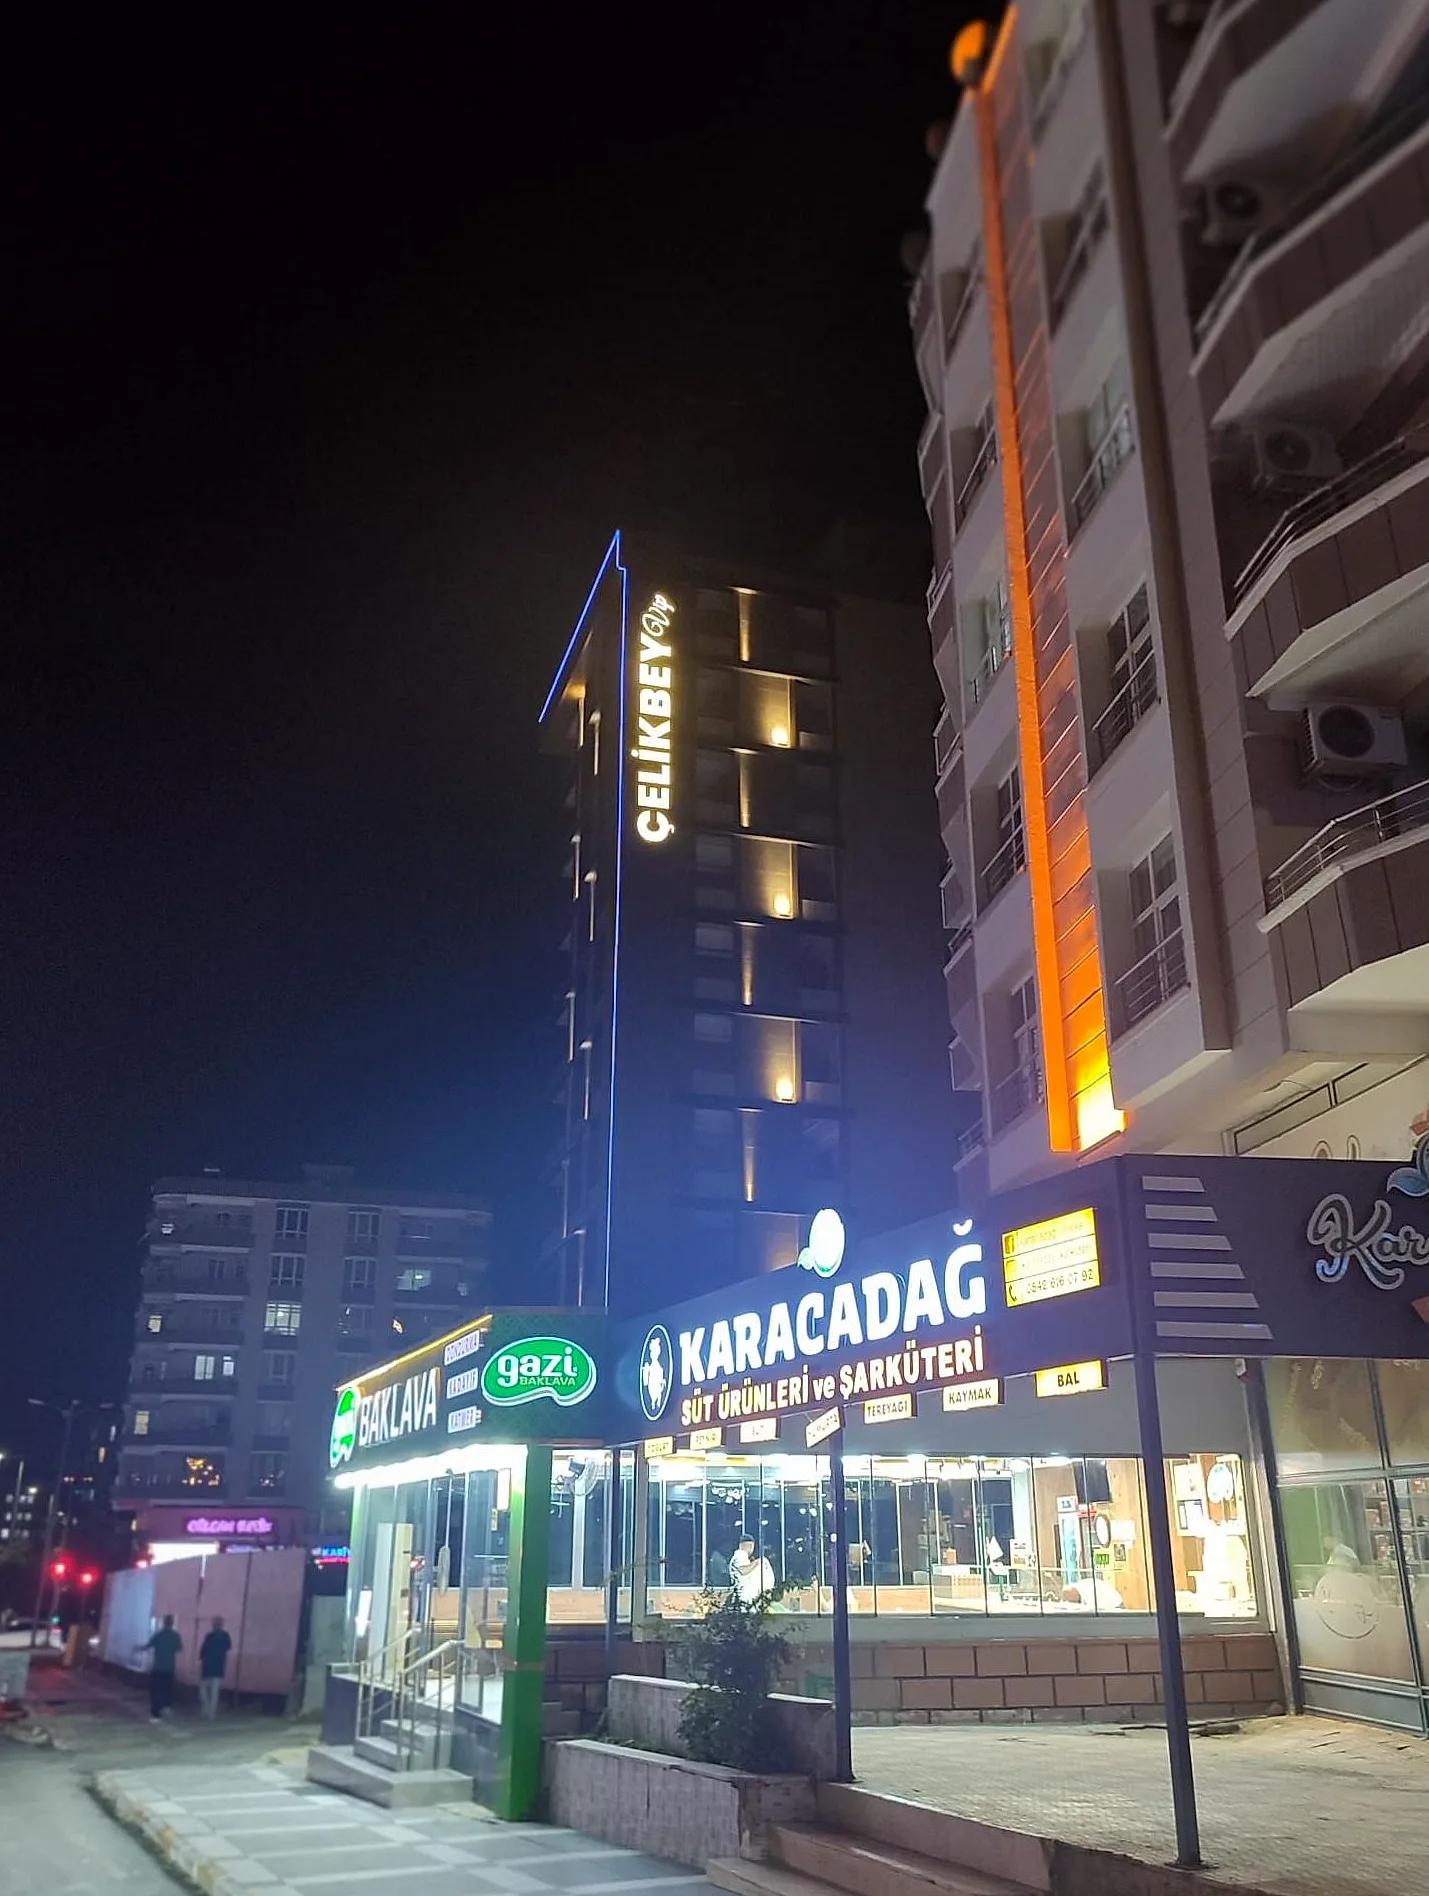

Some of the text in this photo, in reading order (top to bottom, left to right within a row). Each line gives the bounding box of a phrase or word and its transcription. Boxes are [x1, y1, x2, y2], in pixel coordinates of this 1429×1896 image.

[630, 632, 675, 843] ÇELİKBEY
[1307, 1194, 1429, 1290] Kar
[679, 1218, 987, 1385] KARACADAĞ
[358, 1366, 438, 1447] BAKLAVA
[497, 1346, 578, 1388] gazi
[519, 1376, 577, 1387] BAKLAVA
[681, 1324, 985, 1427] SÜT ÜRÜNLERİ ve ŞARKÜTERİ
[949, 1387, 992, 1404] KAYMAK
[1057, 1370, 1080, 1387] BAL
